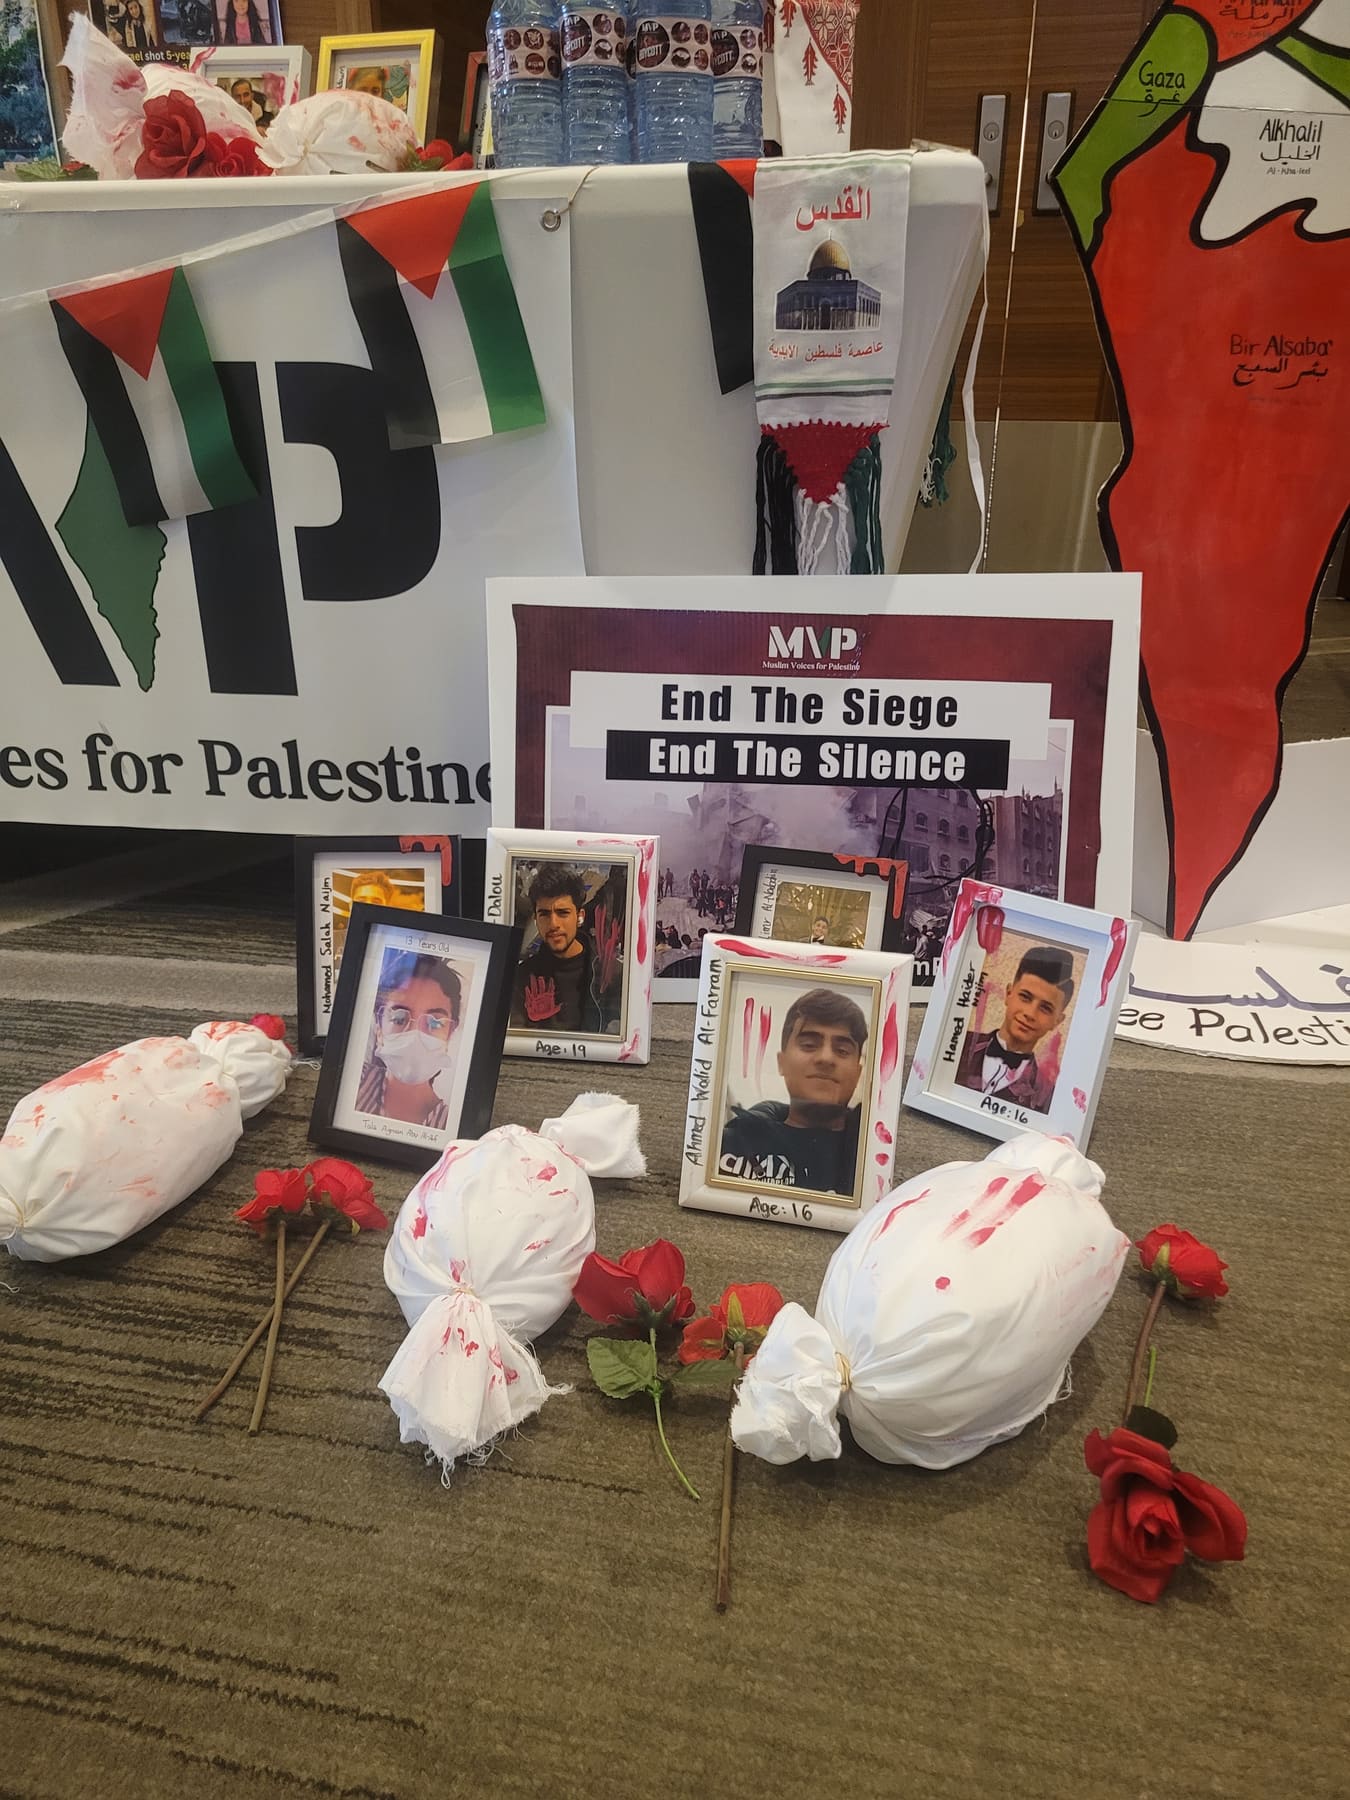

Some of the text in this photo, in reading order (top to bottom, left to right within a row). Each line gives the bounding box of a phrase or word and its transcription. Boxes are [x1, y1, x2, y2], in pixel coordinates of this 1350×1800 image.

[145, 51, 164, 61] shot
[1139, 60, 1185, 89] Gaza
[1259, 119, 1323, 142] Alkhalil
[796, 185, 871, 231] القدس
[804, 344, 843, 362] فلسطين
[848, 341, 884, 358] عاصمة
[1230, 334, 1260, 355] Bir
[768, 626, 857, 660] MVP
[762, 661, 861, 671] Muslim Voices for Palestine
[661, 684, 958, 731] End The Siege
[82, 733, 184, 794] for
[649, 738, 966, 782] End The Silence
[320, 922, 332, 956] Salah
[321, 965, 333, 1013] Mohamed
[943, 959, 975, 1063] Hamed Haider
[572, 1043, 586, 1058] 19
[691, 1058, 713, 1101] Walid
[980, 1095, 1029, 1124] Age: 16
[749, 1196, 813, 1222] Age: 16
